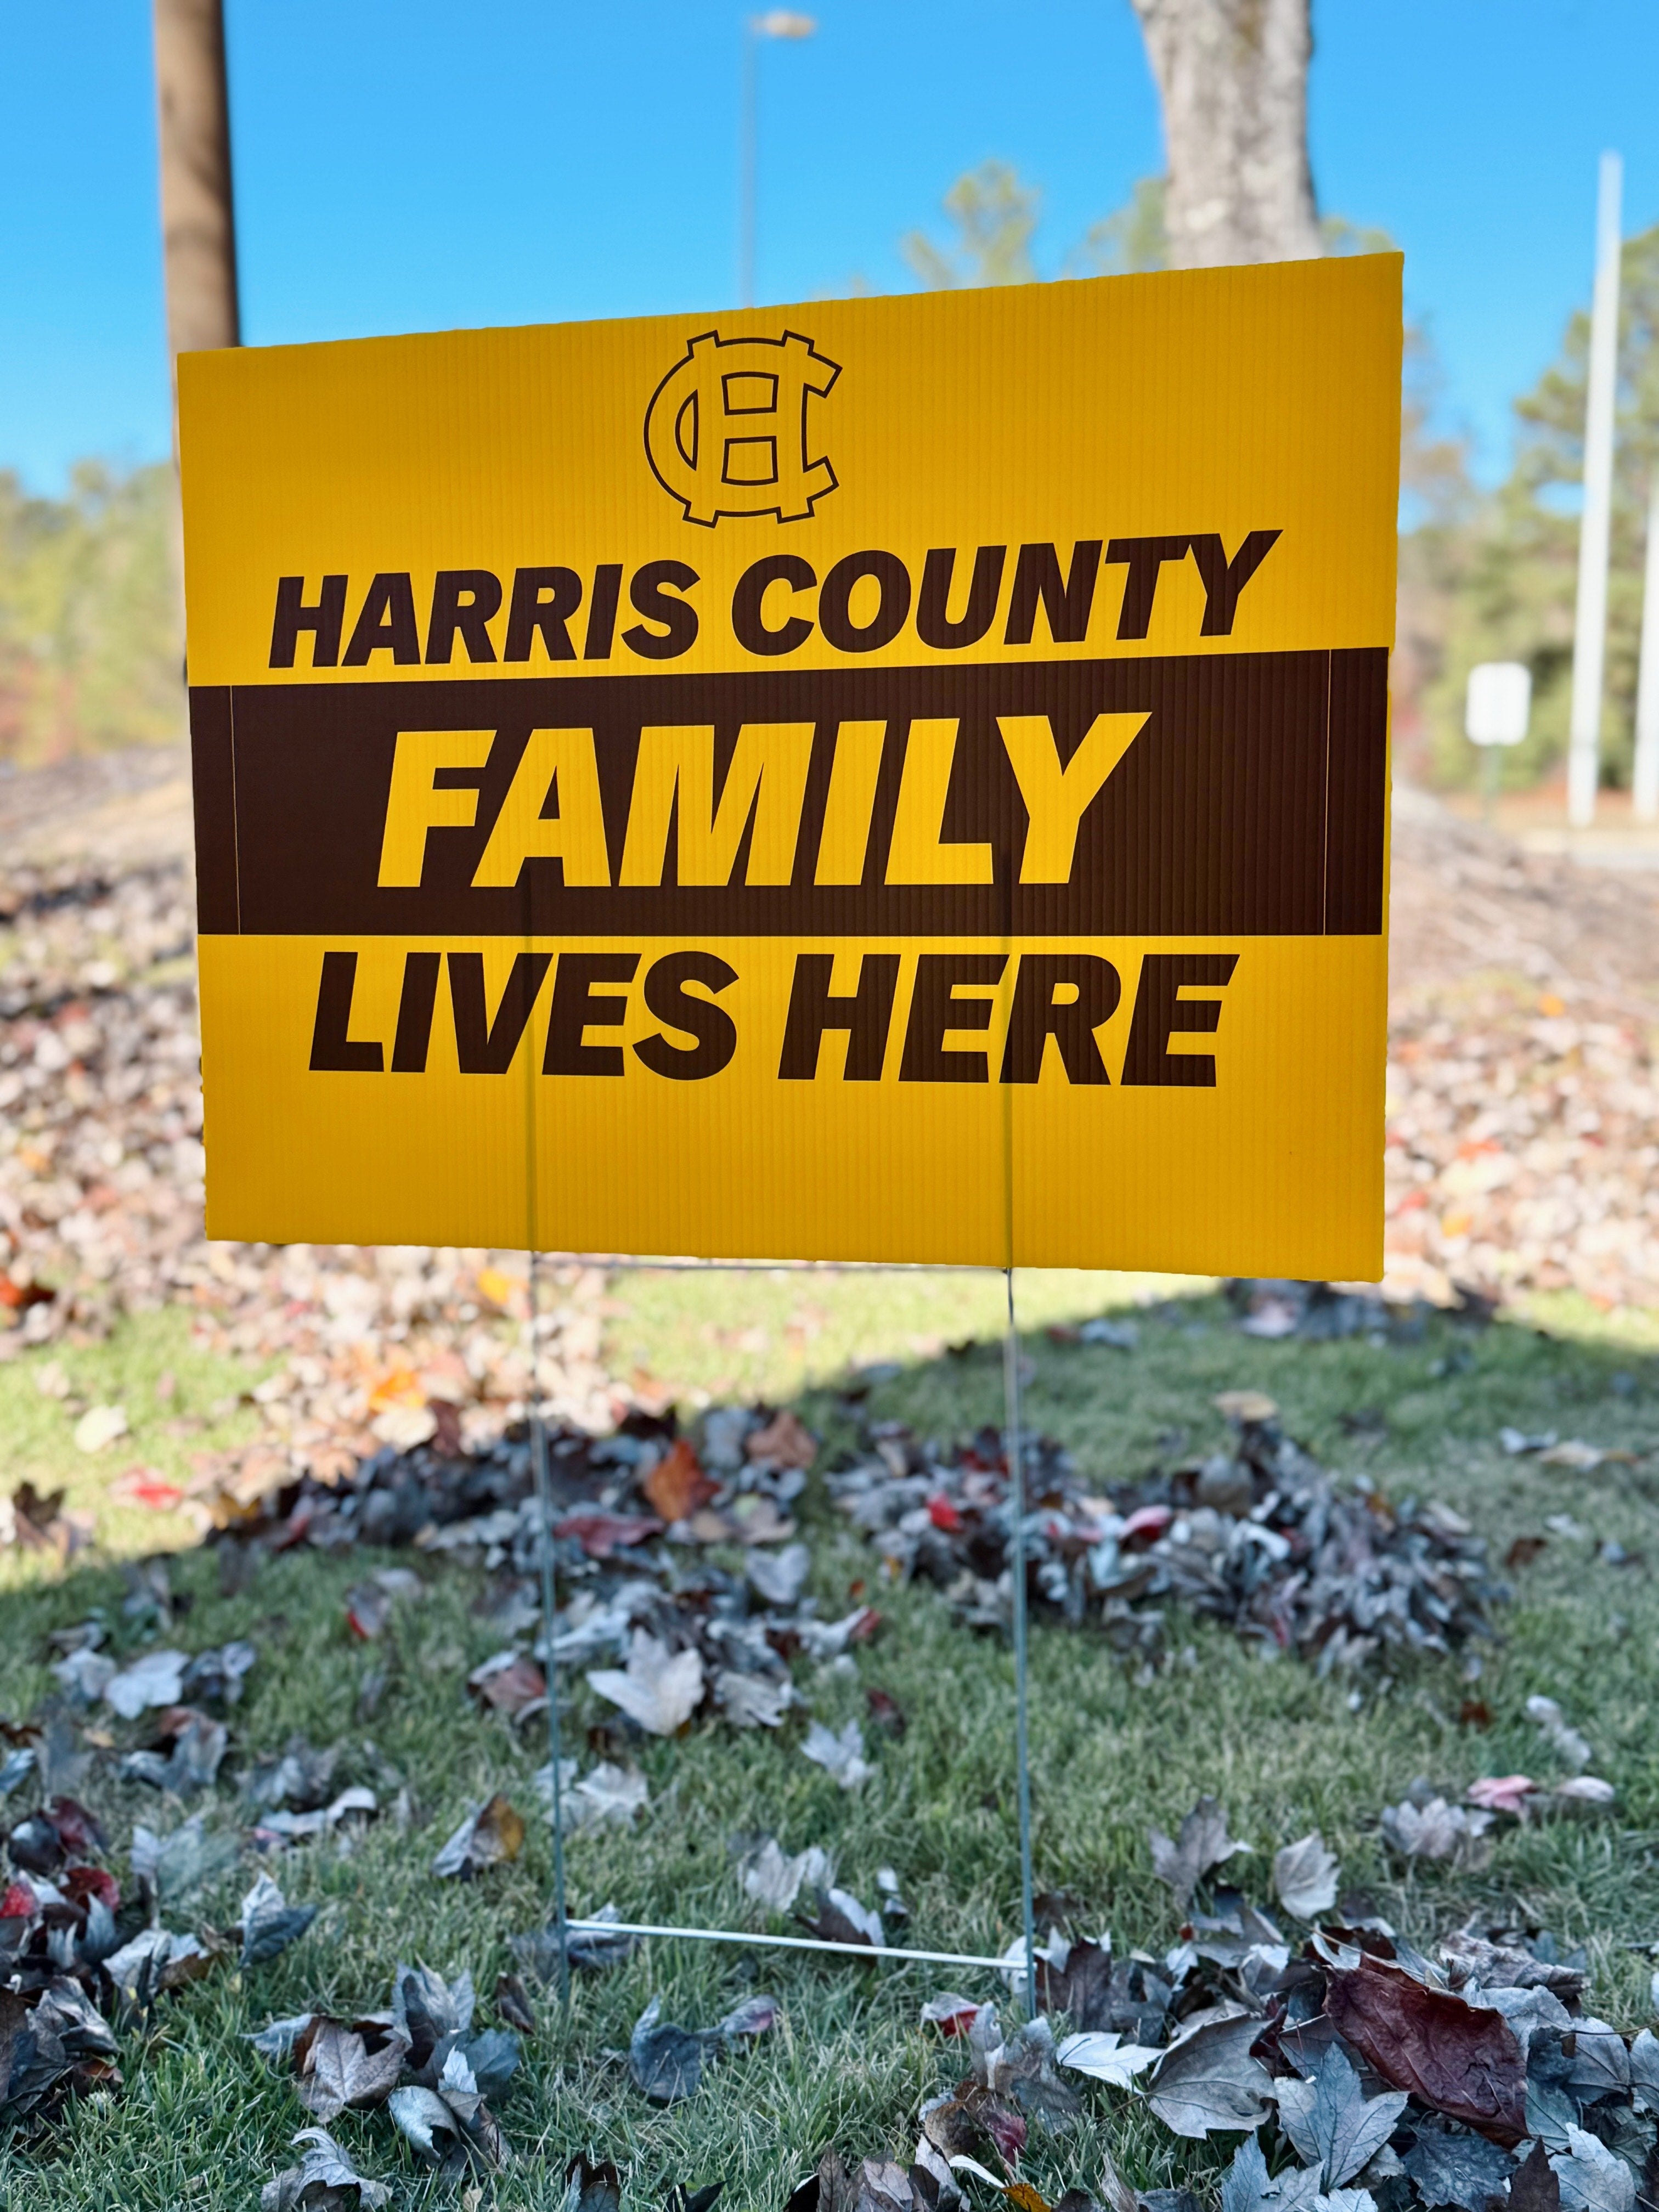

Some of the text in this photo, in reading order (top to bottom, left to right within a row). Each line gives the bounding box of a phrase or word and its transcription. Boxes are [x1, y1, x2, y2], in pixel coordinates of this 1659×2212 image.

[268, 529, 1283, 668] HARRIS COUNTY
[377, 712, 1153, 888] FAMILY
[308, 951, 1240, 1087] LIVES HERE
